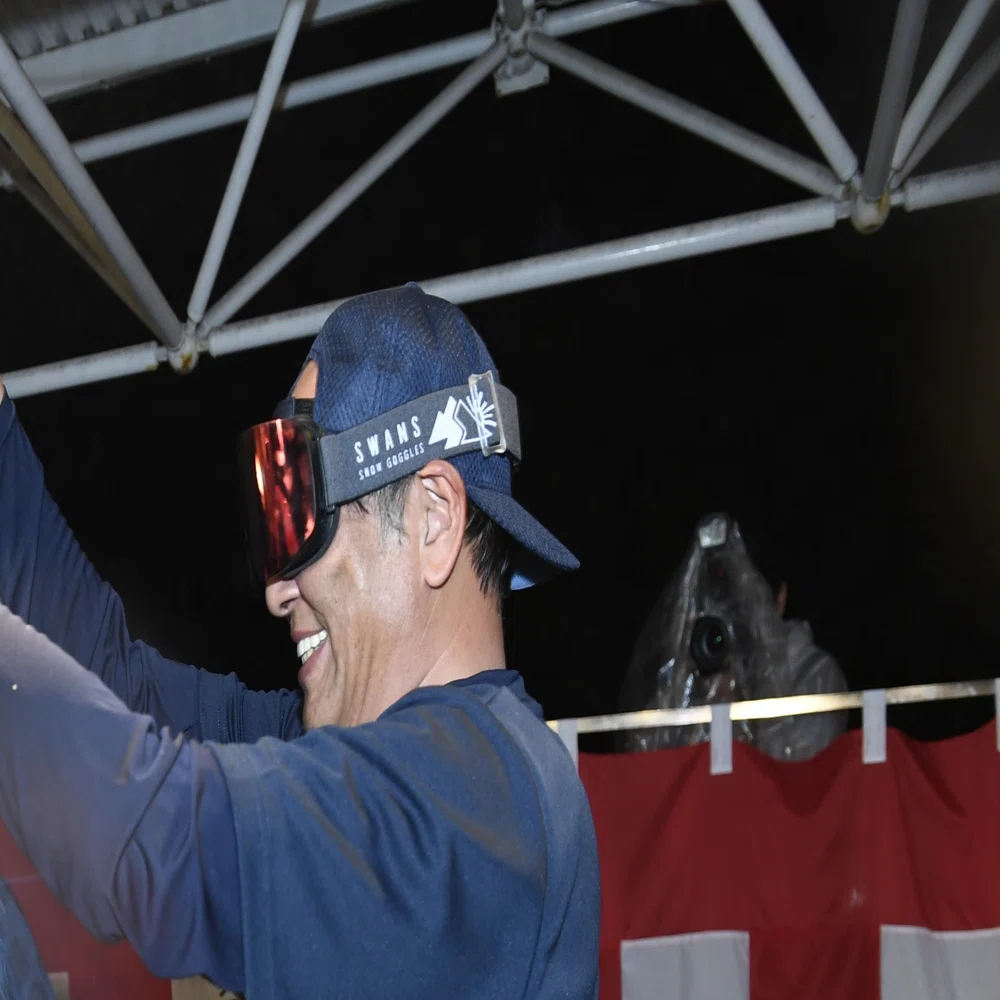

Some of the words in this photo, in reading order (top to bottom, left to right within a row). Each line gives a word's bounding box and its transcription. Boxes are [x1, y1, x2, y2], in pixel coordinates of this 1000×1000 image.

[354, 415, 421, 463] SWANS
[358, 462, 383, 480] SNOW
[386, 442, 425, 469] GOGGLES
